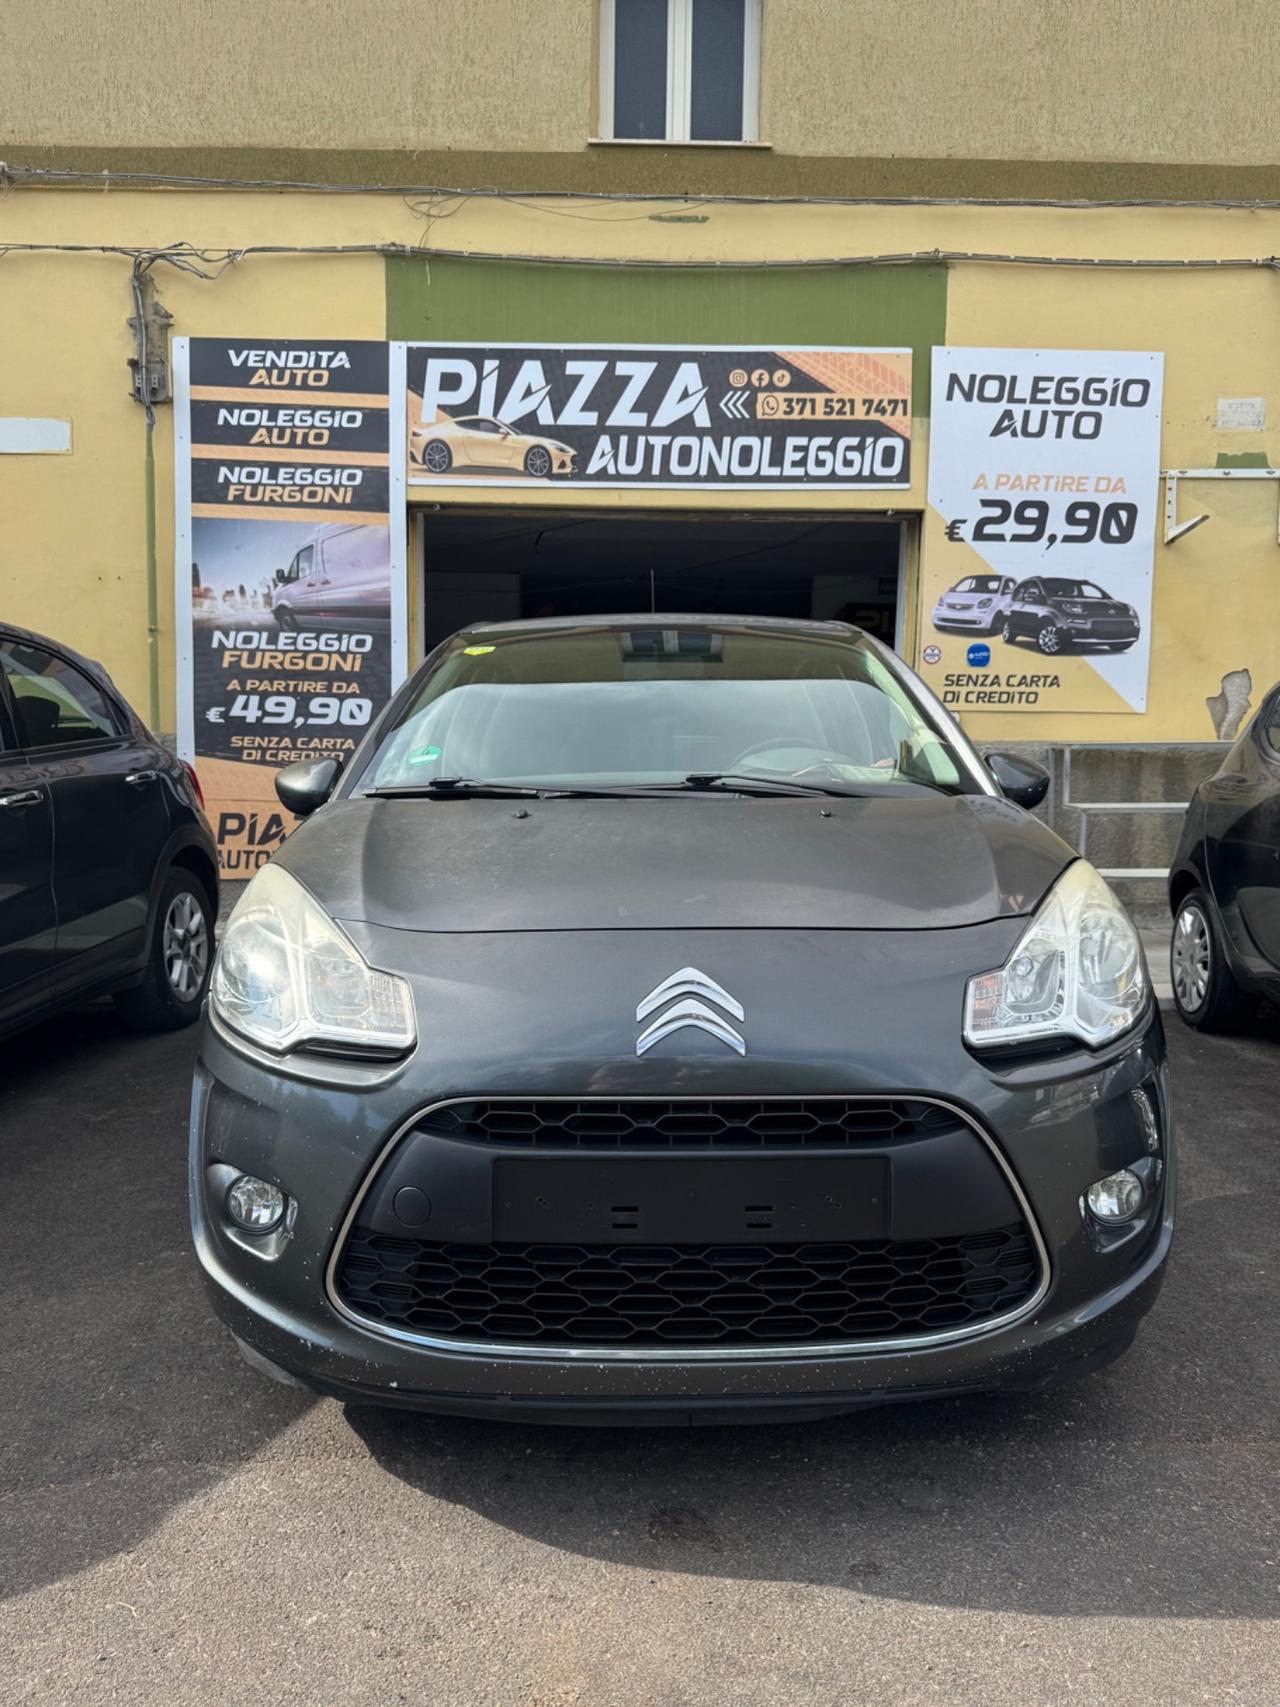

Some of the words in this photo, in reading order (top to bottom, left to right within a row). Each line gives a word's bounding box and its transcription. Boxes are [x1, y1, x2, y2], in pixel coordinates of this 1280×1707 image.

[228, 350, 351, 368] VENDITA
[249, 369, 329, 386] AUTO
[421, 358, 712, 428] PIAZZA
[947, 373, 1151, 407] NOLEGGIO
[783, 398, 816, 416] 371
[823, 399, 855, 416] 521
[862, 399, 908, 417] 7471
[217, 408, 363, 428] NOLEGGIO
[989, 409, 1103, 439] AUTO
[249, 428, 329, 445] AUTO
[585, 435, 905, 476] AUTONOLEGGIO
[217, 466, 363, 486] NOLEGGIO
[972, 474, 988, 490] A
[994, 474, 1089, 493] PARTIRE
[1094, 476, 1127, 494] DA
[227, 485, 353, 504] FURGONI
[972, 498, 1138, 550] 29,90
[211, 630, 373, 653] NOLEGGIO
[221, 651, 362, 672] FURGONI
[226, 679, 241, 691] A
[246, 680, 326, 693] PARTIRE
[332, 681, 360, 694] DA
[944, 674, 1001, 687] SENZA
[1005, 675, 1061, 688] CARTA
[942, 691, 960, 704] DI
[964, 691, 1039, 705] CREDITO
[229, 695, 373, 729] 49,90
[230, 736, 292, 748] SENZA
[296, 738, 355, 749] CARTA
[242, 749, 261, 761] DI
[217, 812, 304, 846] PIA
